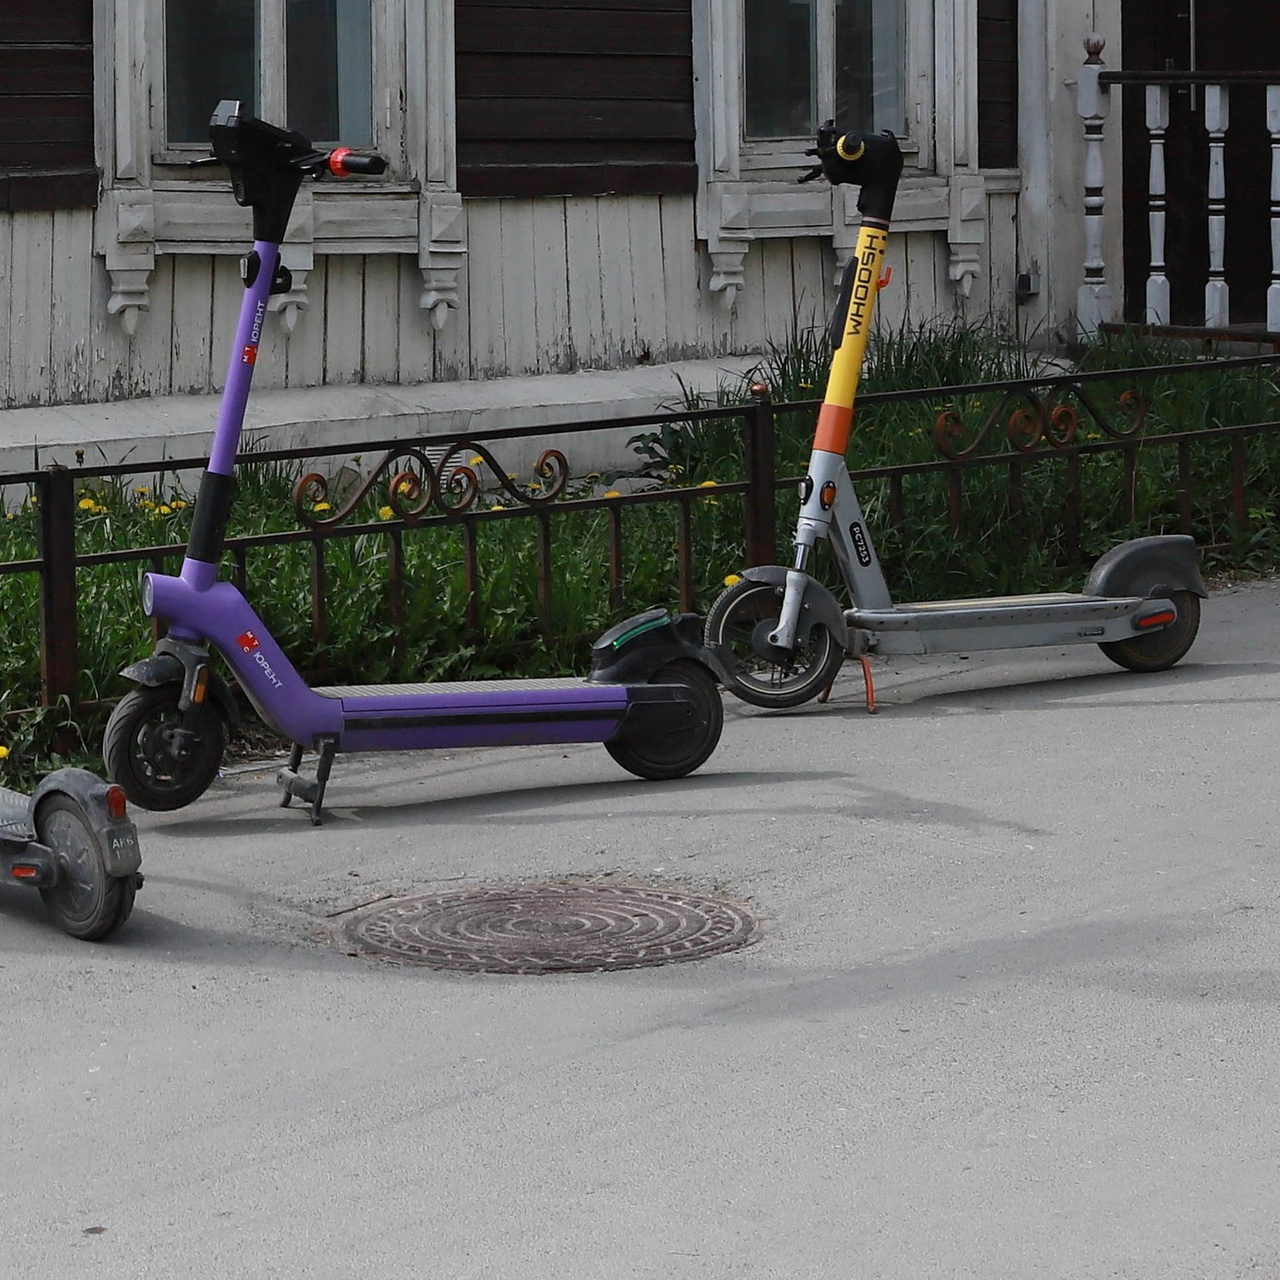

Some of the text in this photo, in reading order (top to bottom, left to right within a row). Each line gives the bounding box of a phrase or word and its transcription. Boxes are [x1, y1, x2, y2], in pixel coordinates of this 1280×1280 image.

[847, 234, 879, 336] WHOOSH
[251, 300, 265, 343] ЮРЕНТ
[852, 526, 870, 563] PC7253
[253, 651, 283, 688] ЮРЕНТ
